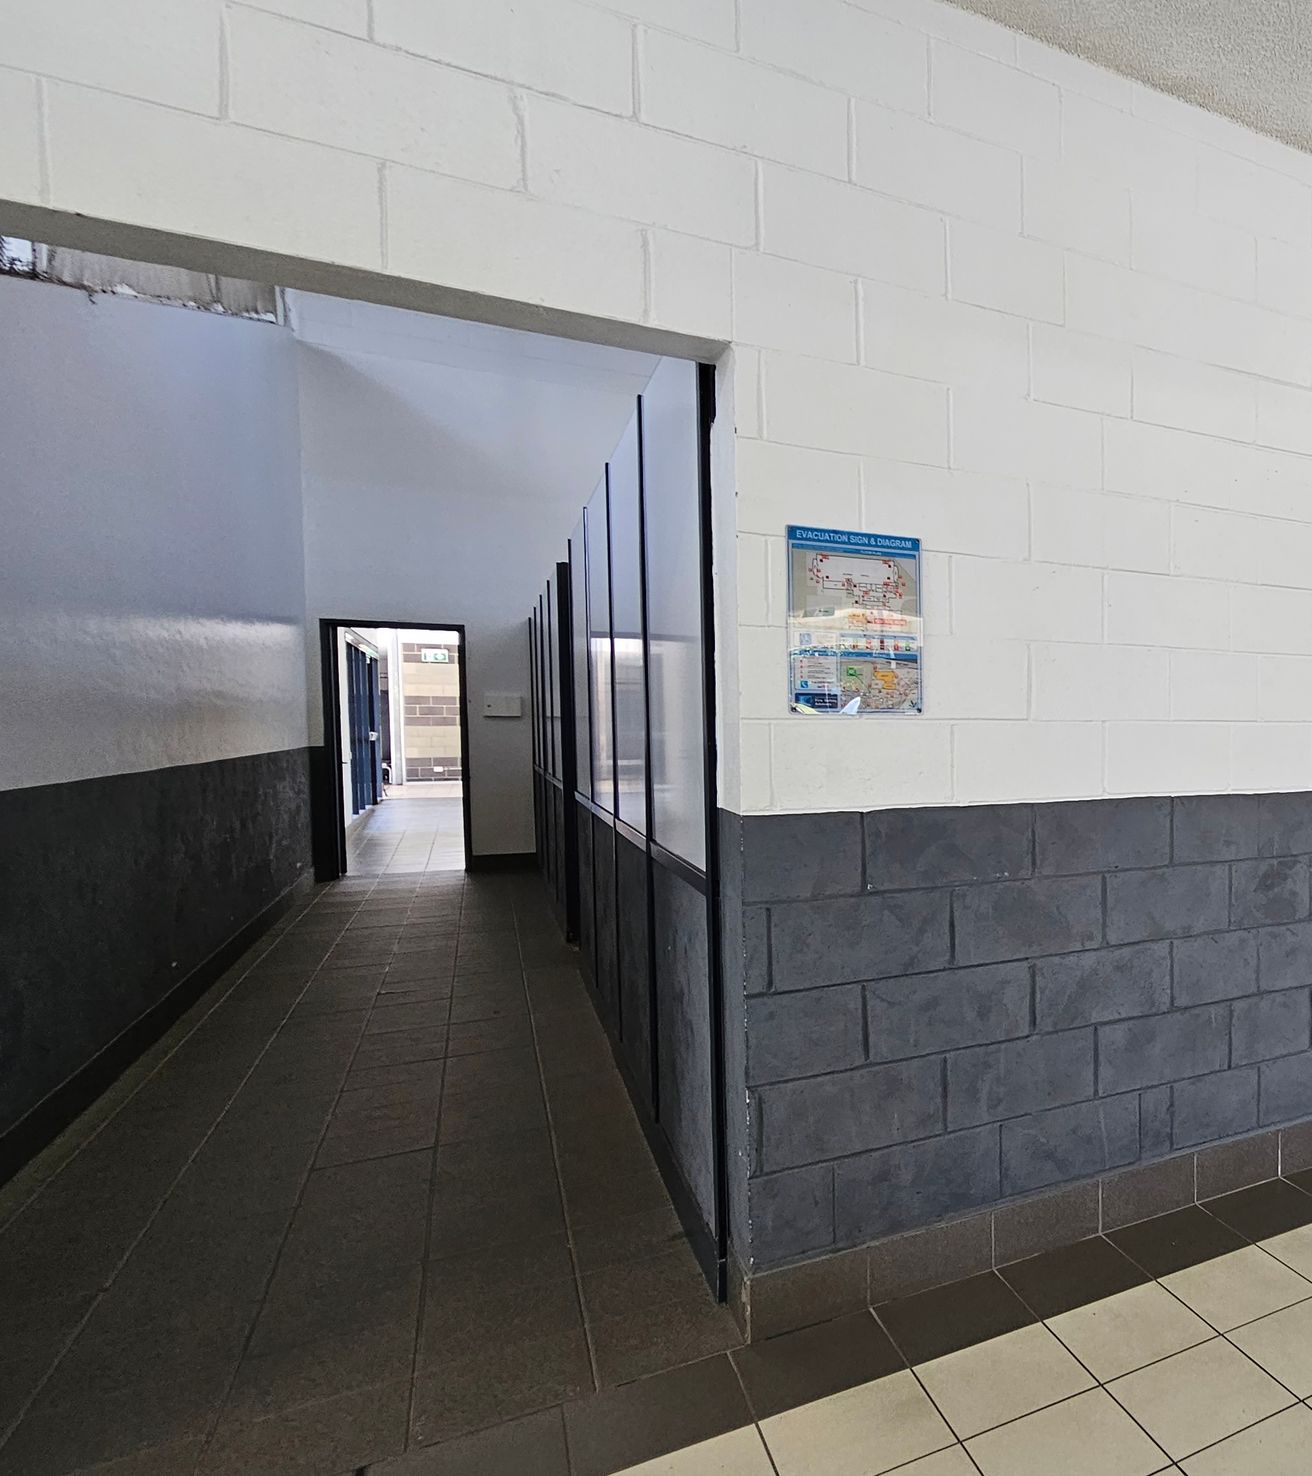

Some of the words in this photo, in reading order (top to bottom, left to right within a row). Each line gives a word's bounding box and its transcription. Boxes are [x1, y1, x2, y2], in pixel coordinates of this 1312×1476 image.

[796, 530, 848, 542] EVACUATION
[849, 535, 869, 544] SIGN
[877, 539, 912, 548] DIAGRAM
